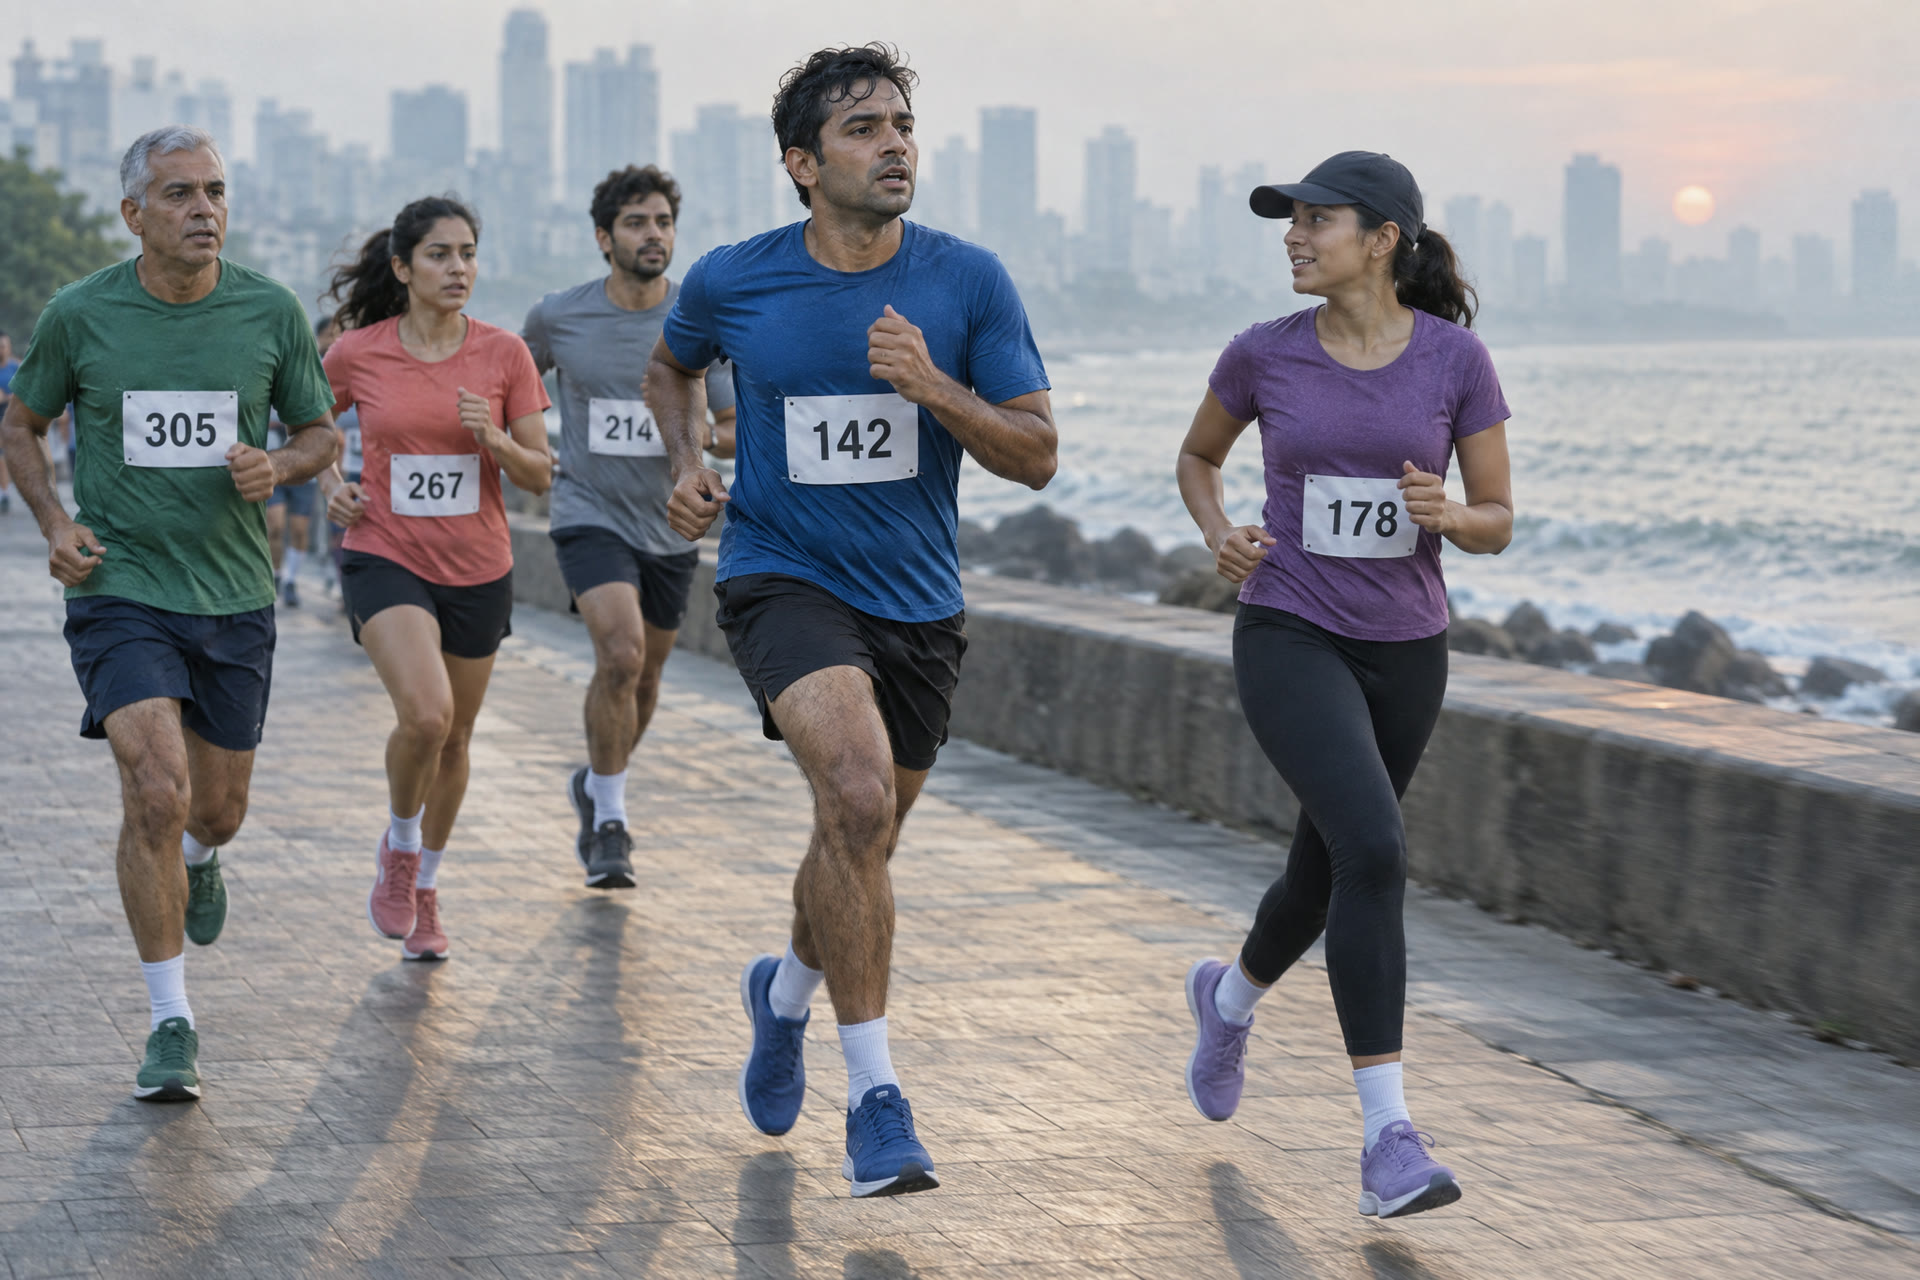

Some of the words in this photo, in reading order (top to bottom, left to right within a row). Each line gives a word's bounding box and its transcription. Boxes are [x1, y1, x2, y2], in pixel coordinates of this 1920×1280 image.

[145, 412, 217, 447] 305
[605, 415, 653, 442] 214
[813, 418, 892, 461] 142
[408, 472, 464, 500] 267
[1328, 500, 1398, 538] 178
